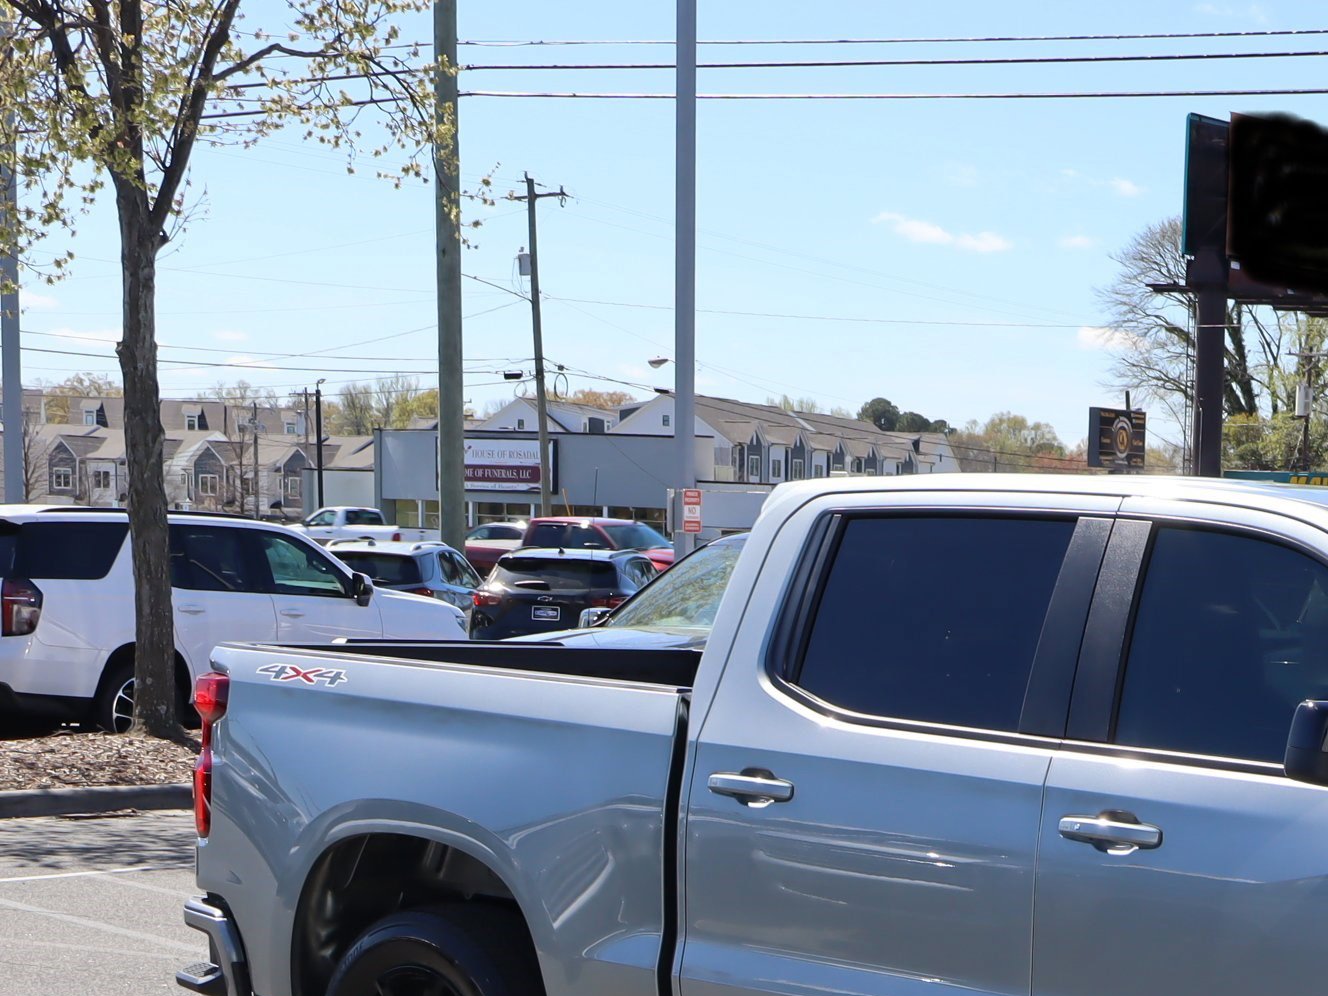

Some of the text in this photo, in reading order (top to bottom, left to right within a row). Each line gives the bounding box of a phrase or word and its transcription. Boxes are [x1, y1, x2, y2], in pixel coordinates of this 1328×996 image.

[472, 449, 539, 460] HOUSE OF ROSADAL
[475, 468, 484, 478] OF
[485, 468, 518, 479] FUNERALS,
[519, 469, 531, 479] LLC
